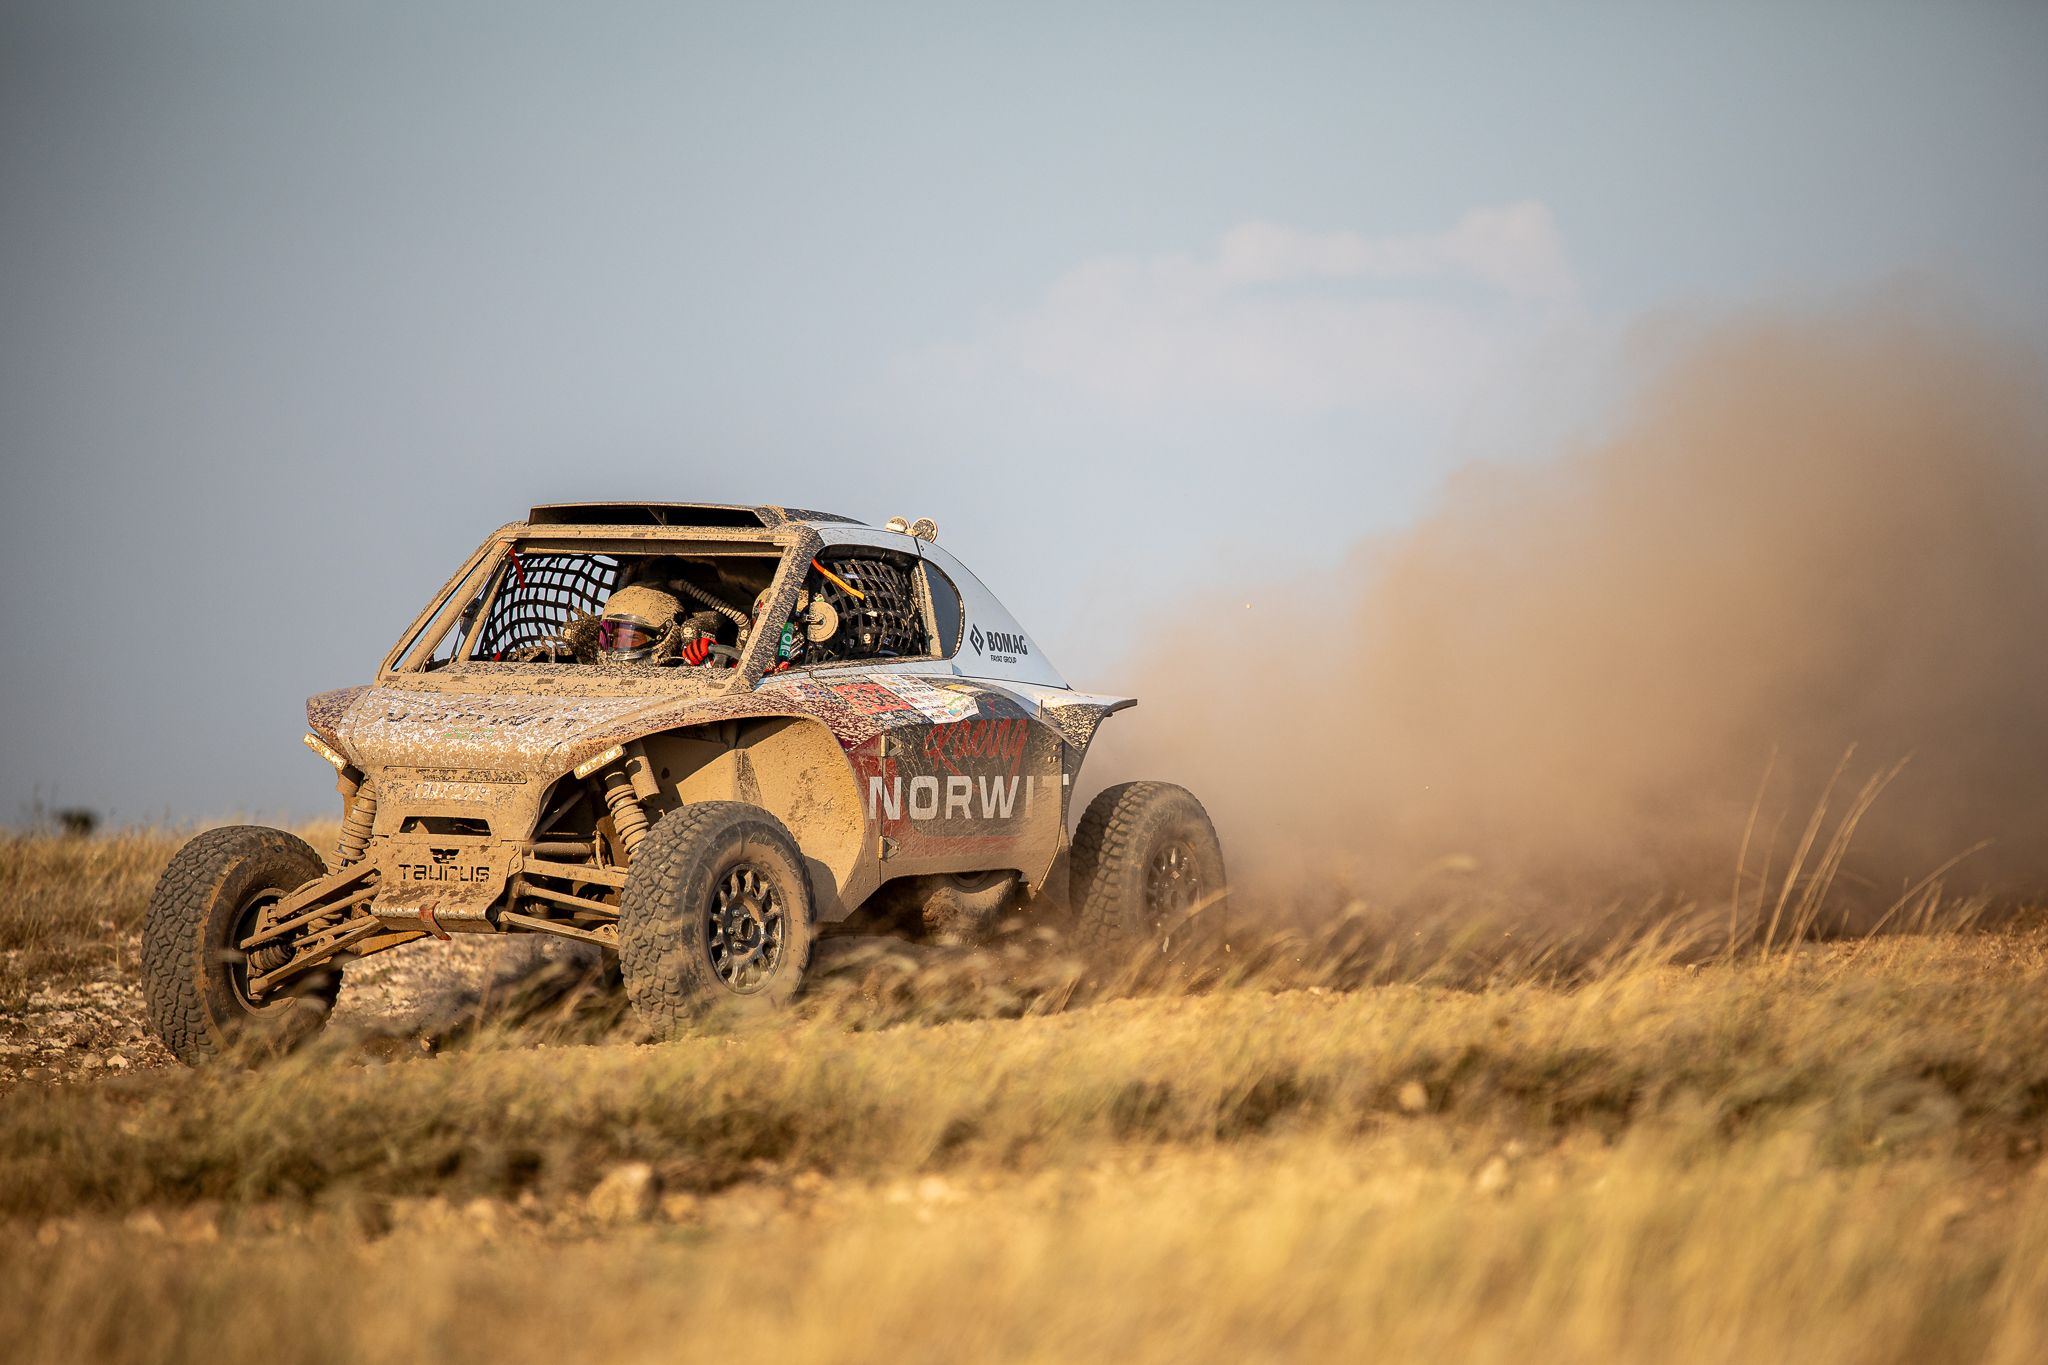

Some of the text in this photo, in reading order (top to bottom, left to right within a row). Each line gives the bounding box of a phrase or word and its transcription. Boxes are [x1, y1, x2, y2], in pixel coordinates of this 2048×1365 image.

[986, 631, 1028, 655] BOMAG
[1003, 655, 1017, 664] GROUP
[923, 698, 1030, 791] Racing
